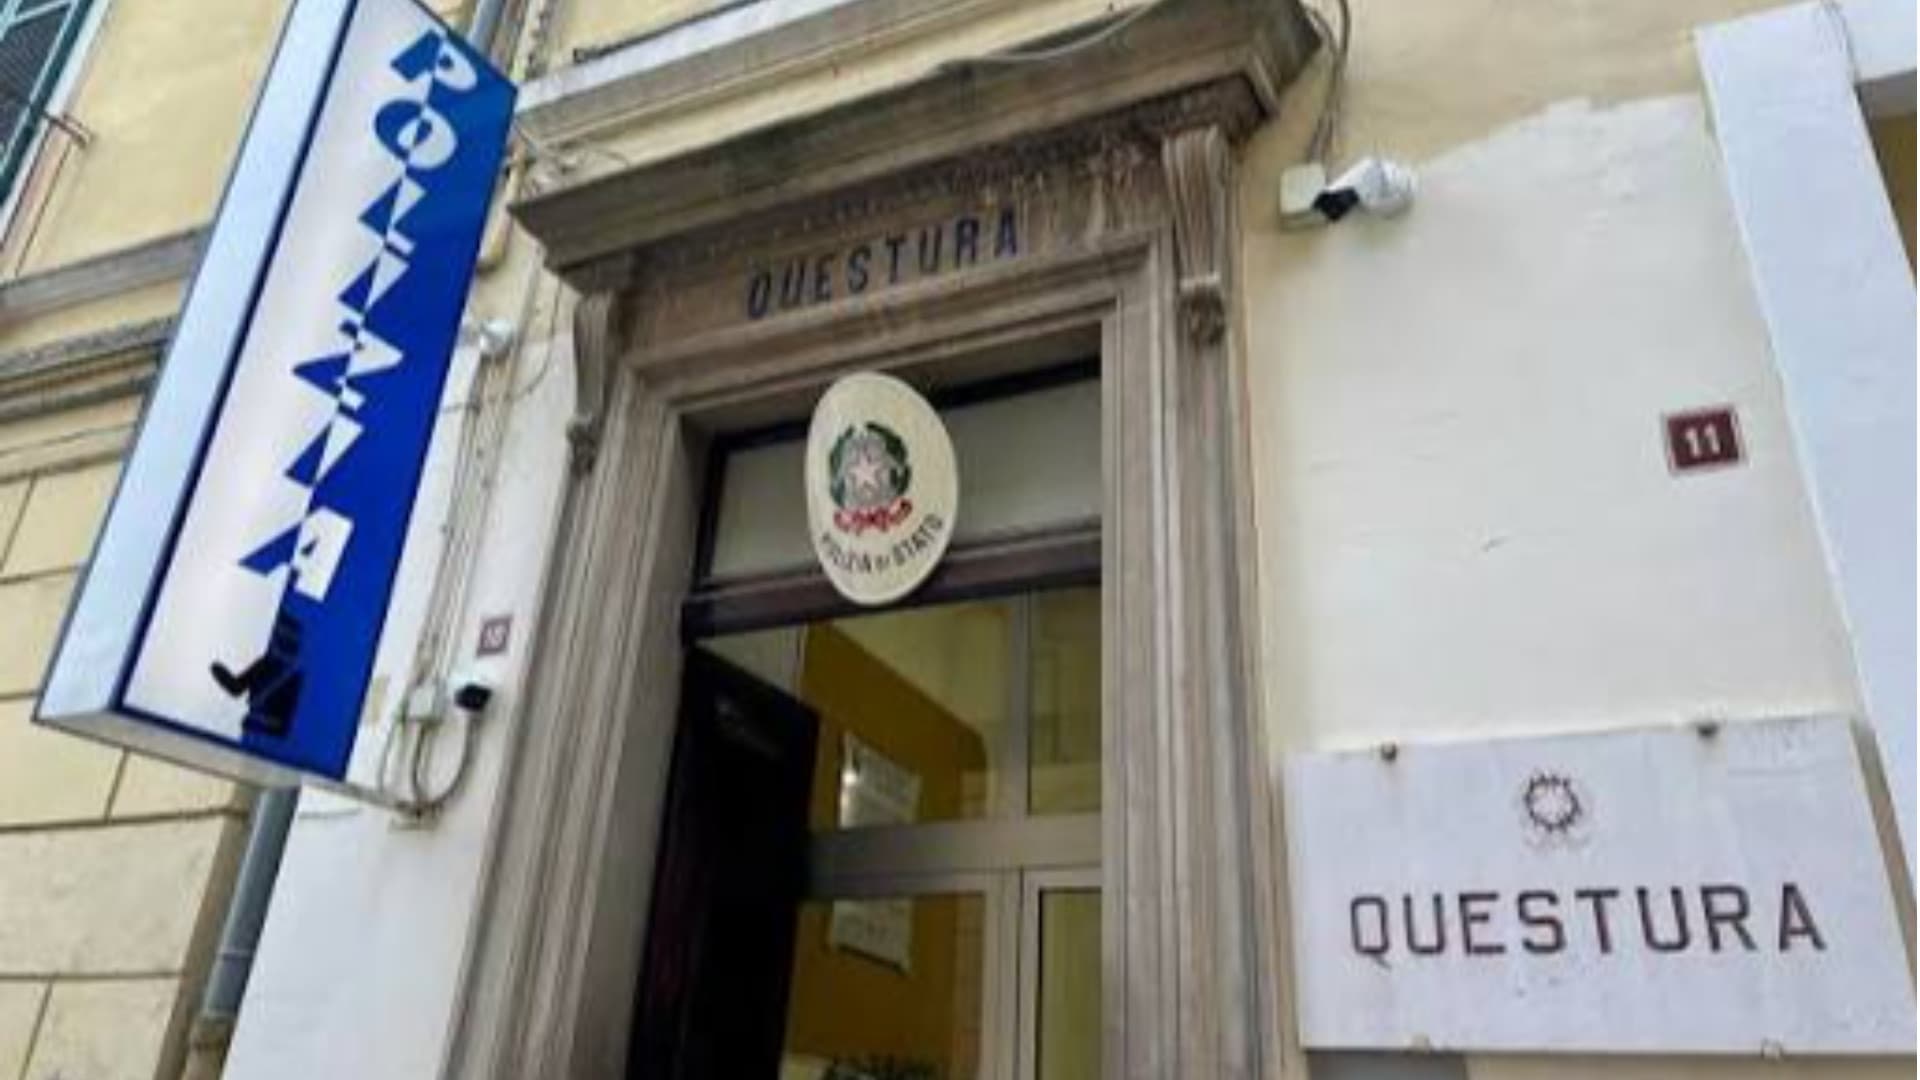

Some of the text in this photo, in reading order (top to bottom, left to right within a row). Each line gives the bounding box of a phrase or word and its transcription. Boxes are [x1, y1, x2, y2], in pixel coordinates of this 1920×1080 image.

[747, 208, 1020, 320] QUESTURA
[238, 29, 478, 601] POLIZIA
[1685, 423, 1721, 457] 11
[1349, 882, 1826, 970] QUESTURA
